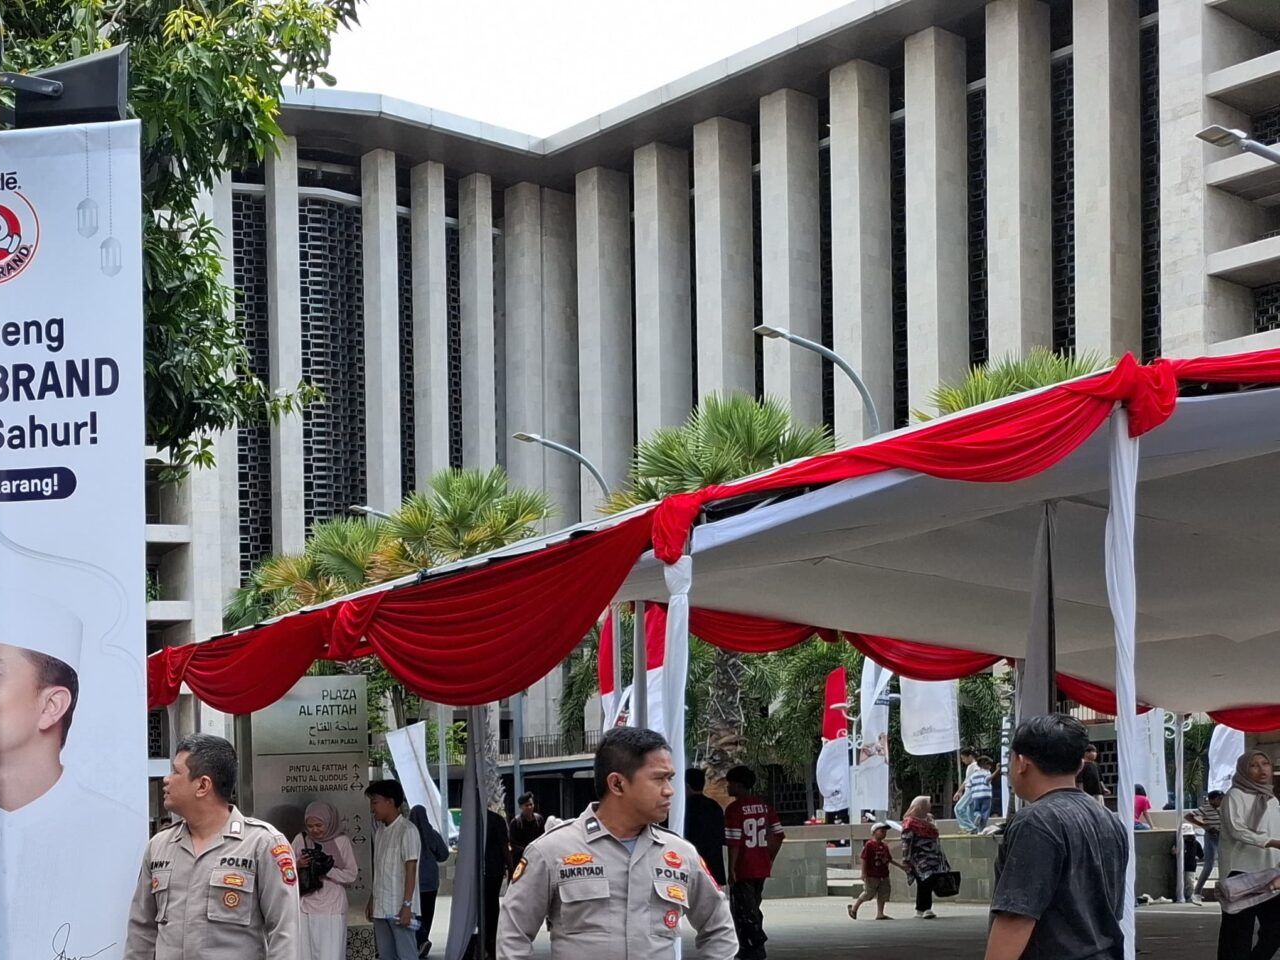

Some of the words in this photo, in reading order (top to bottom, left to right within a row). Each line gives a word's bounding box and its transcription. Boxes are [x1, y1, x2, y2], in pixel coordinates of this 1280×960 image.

[322, 689, 357, 701] PLAZA
[299, 705, 313, 716] AL
[316, 704, 357, 716] FATTAH
[289, 765, 310, 773] PINTU
[322, 764, 348, 772] FATTAH
[286, 775, 308, 783] PINTU
[281, 784, 318, 793] PENITIPAN
[320, 784, 348, 792] BARANG
[220, 857, 253, 870] POLRI
[656, 867, 689, 884] POLRI
